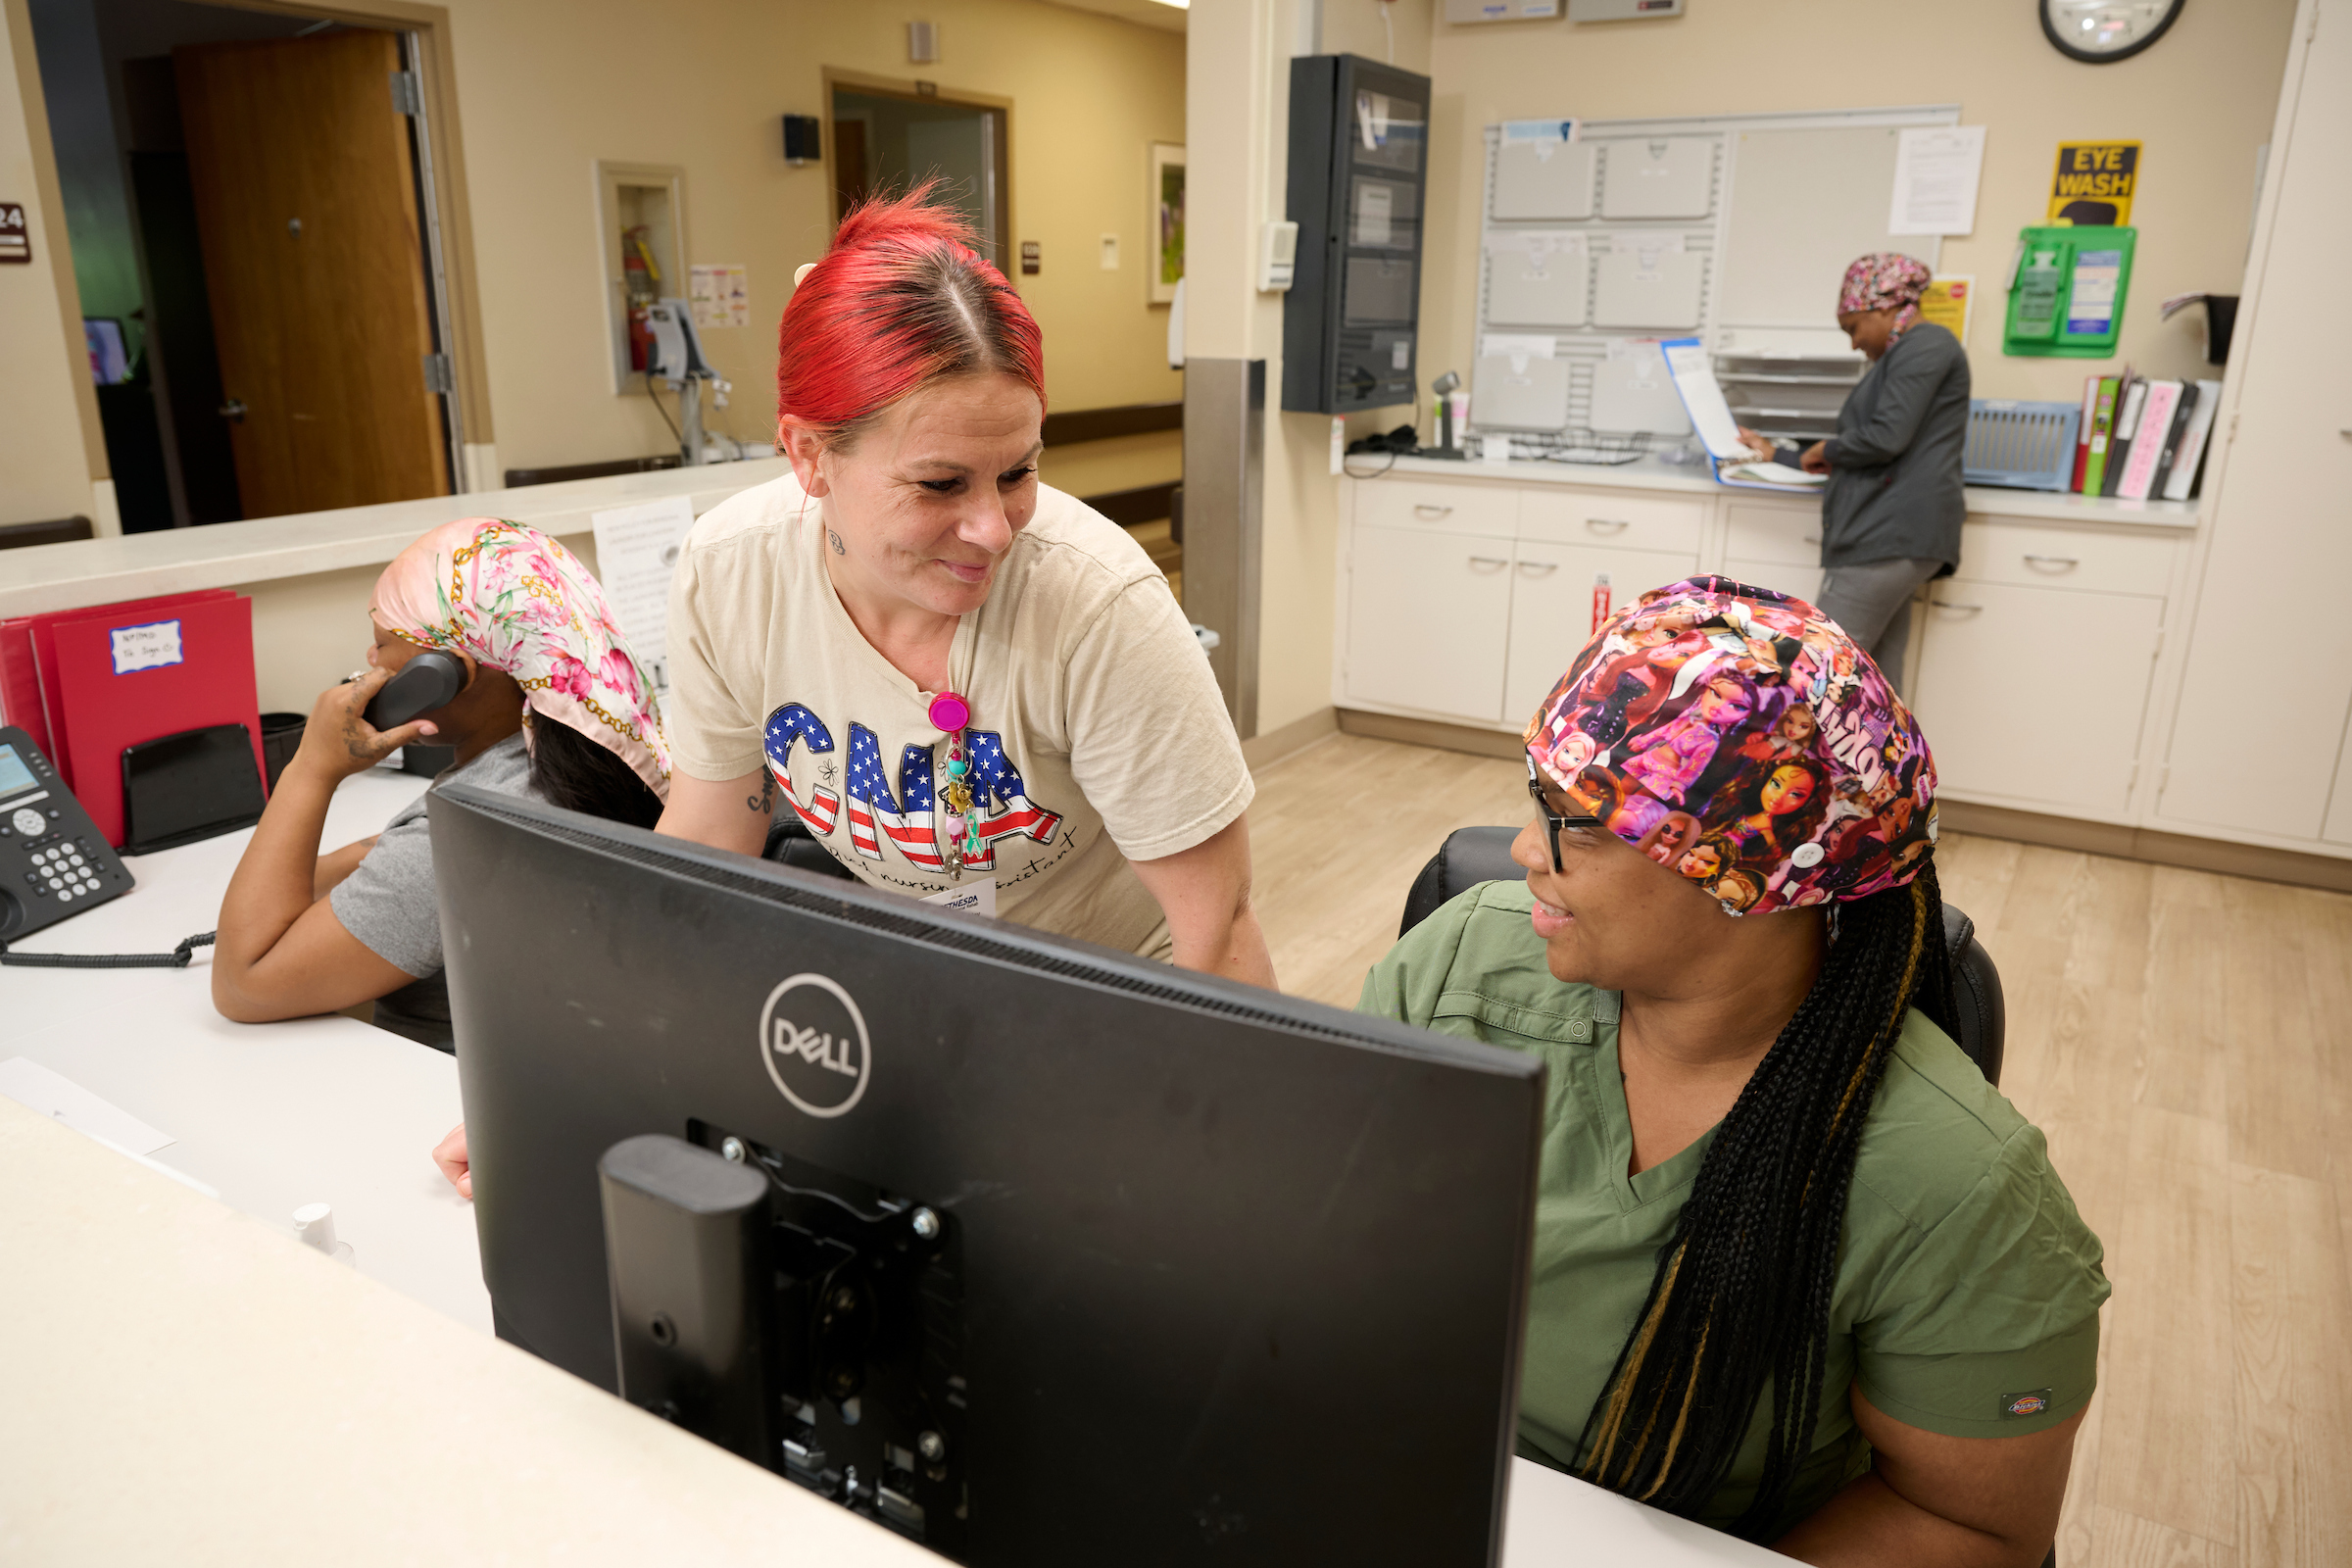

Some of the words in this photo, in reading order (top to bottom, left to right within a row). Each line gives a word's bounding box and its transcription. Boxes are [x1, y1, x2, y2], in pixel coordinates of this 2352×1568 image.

[2058, 172, 2132, 195] WASH
[2073, 147, 2125, 171] EYE
[763, 702, 1064, 874] CNA
[880, 872, 950, 892] nursin
[995, 825, 1078, 890] ssistant
[772, 1016, 859, 1078] DELL
